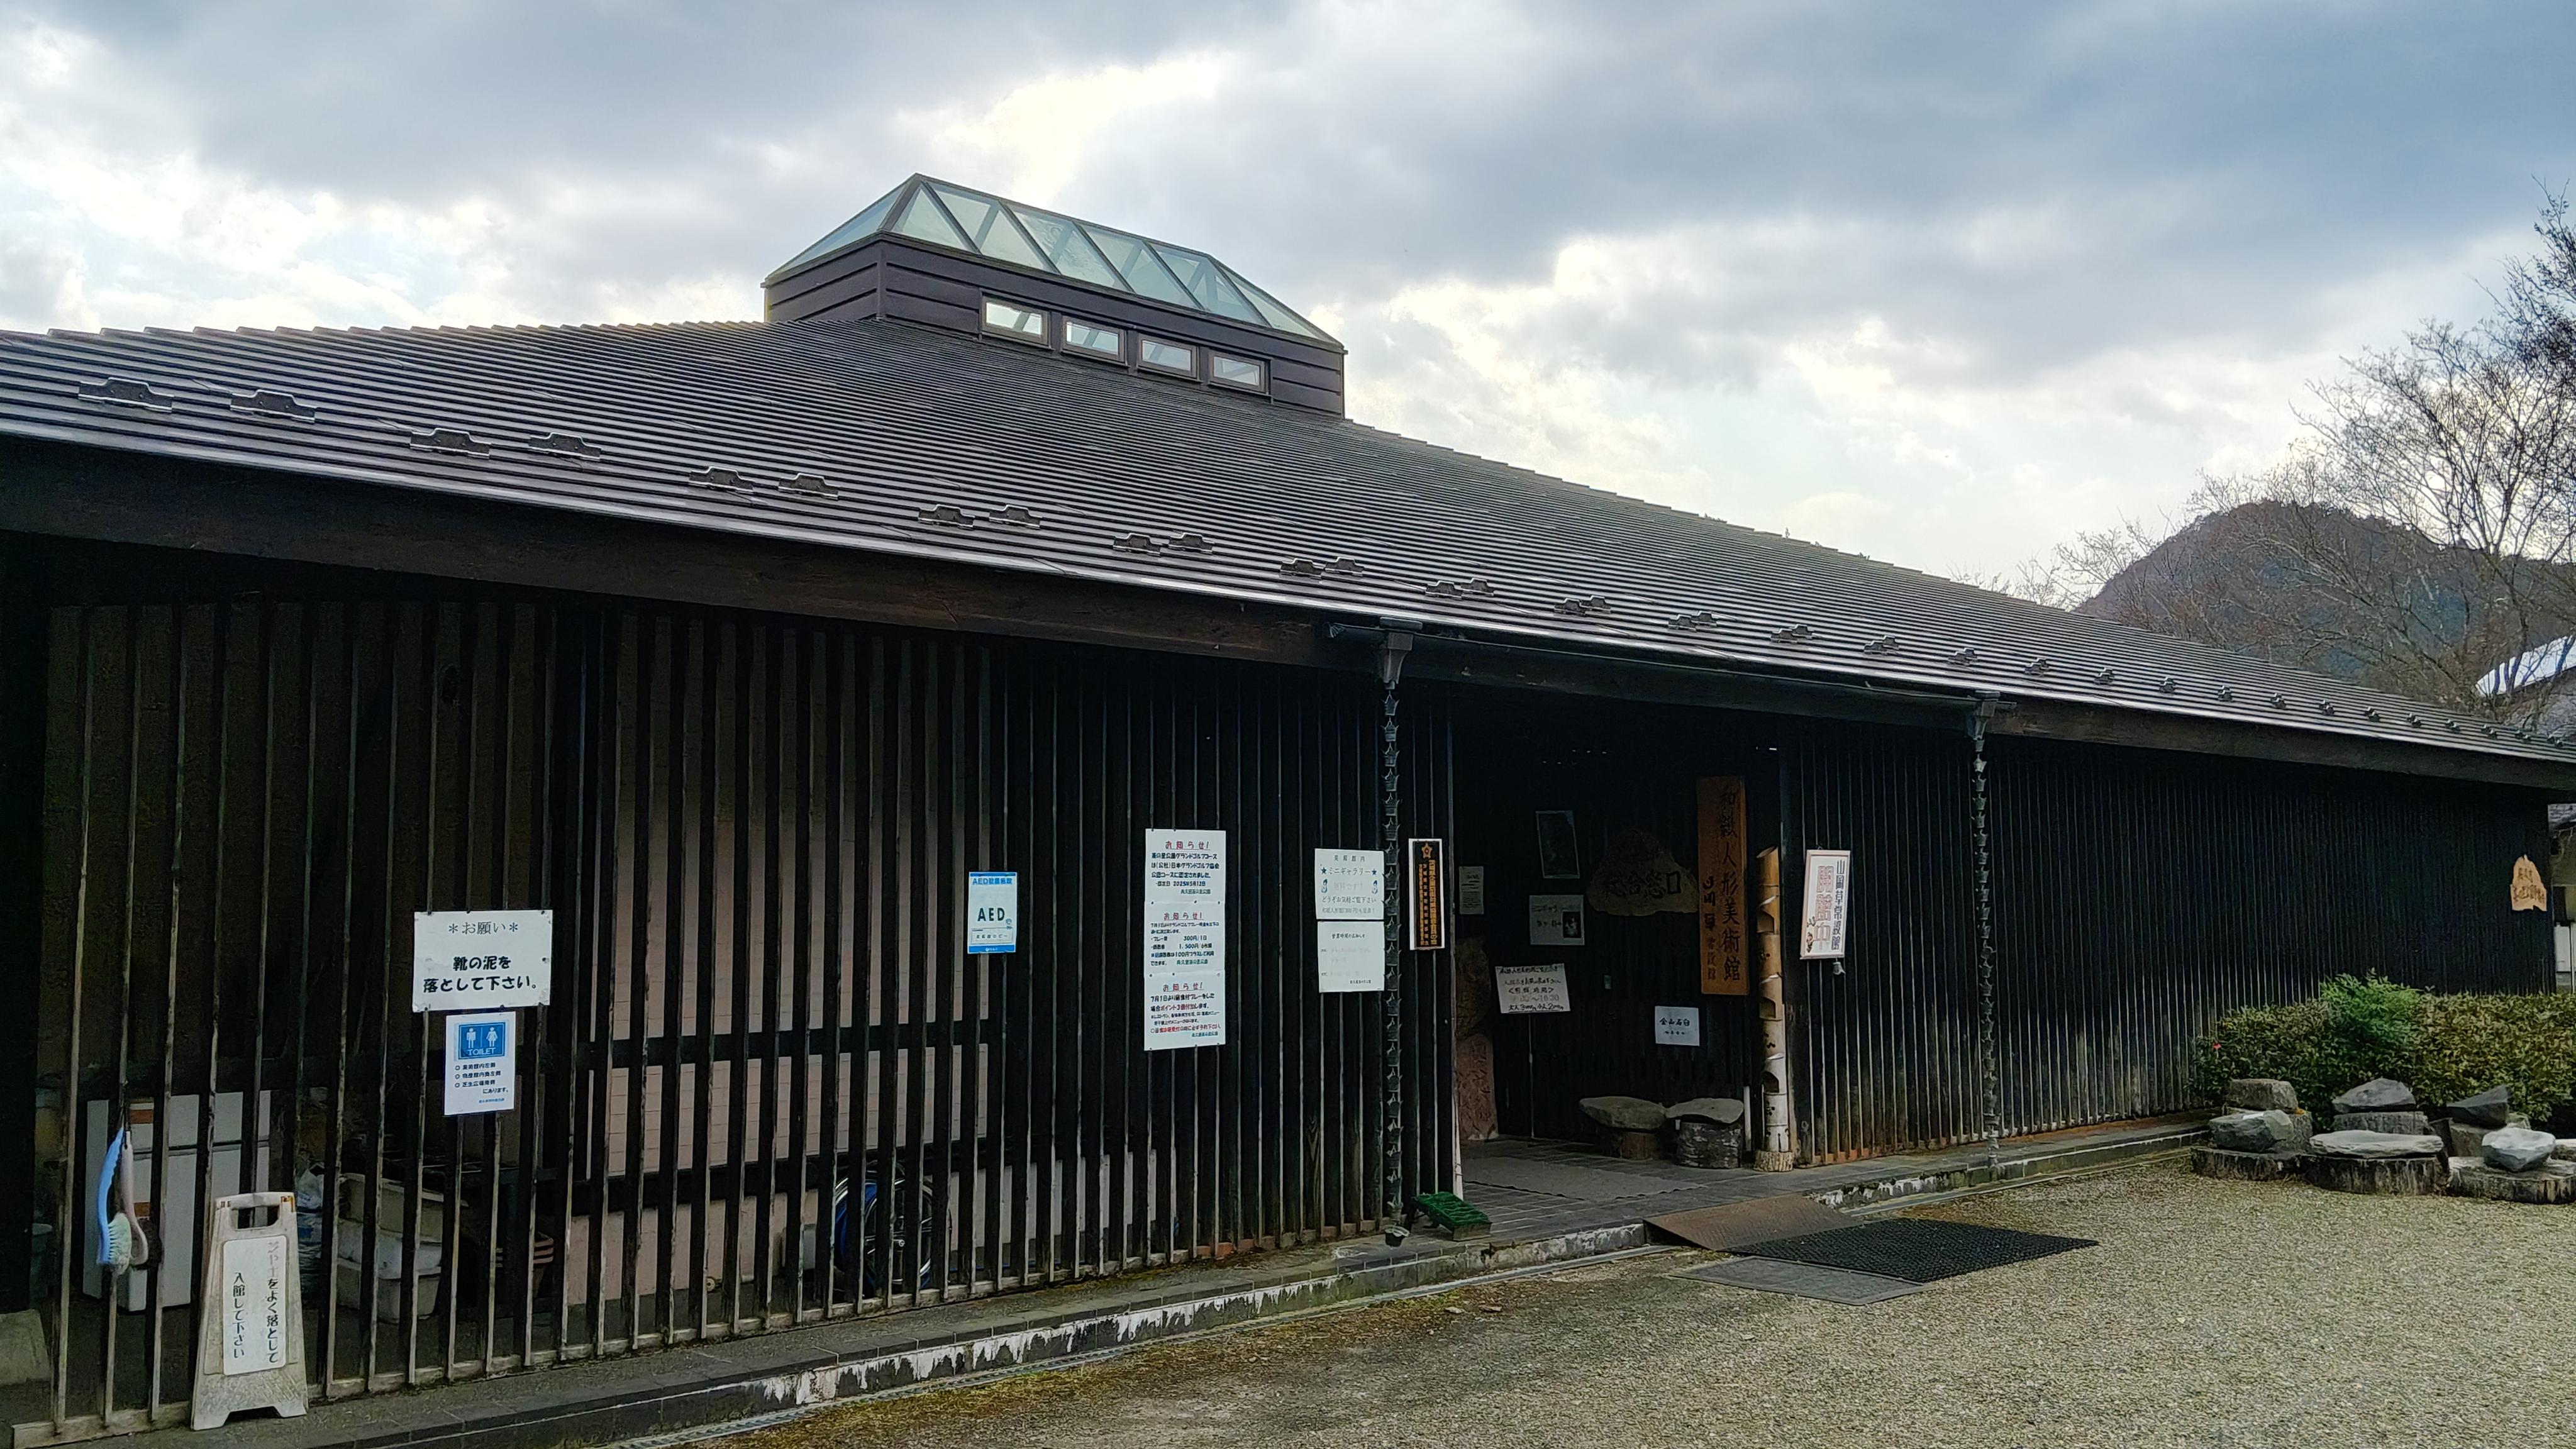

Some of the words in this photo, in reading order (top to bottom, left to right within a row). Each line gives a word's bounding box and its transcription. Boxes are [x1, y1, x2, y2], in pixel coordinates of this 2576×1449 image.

[977, 908, 1005, 921] AED
[453, 956, 511, 972] 靴の泥を
[423, 975, 537, 993] 落として下さい。
[467, 1046, 497, 1056] TOILET
[233, 1272, 245, 1358] 入館して下さい
